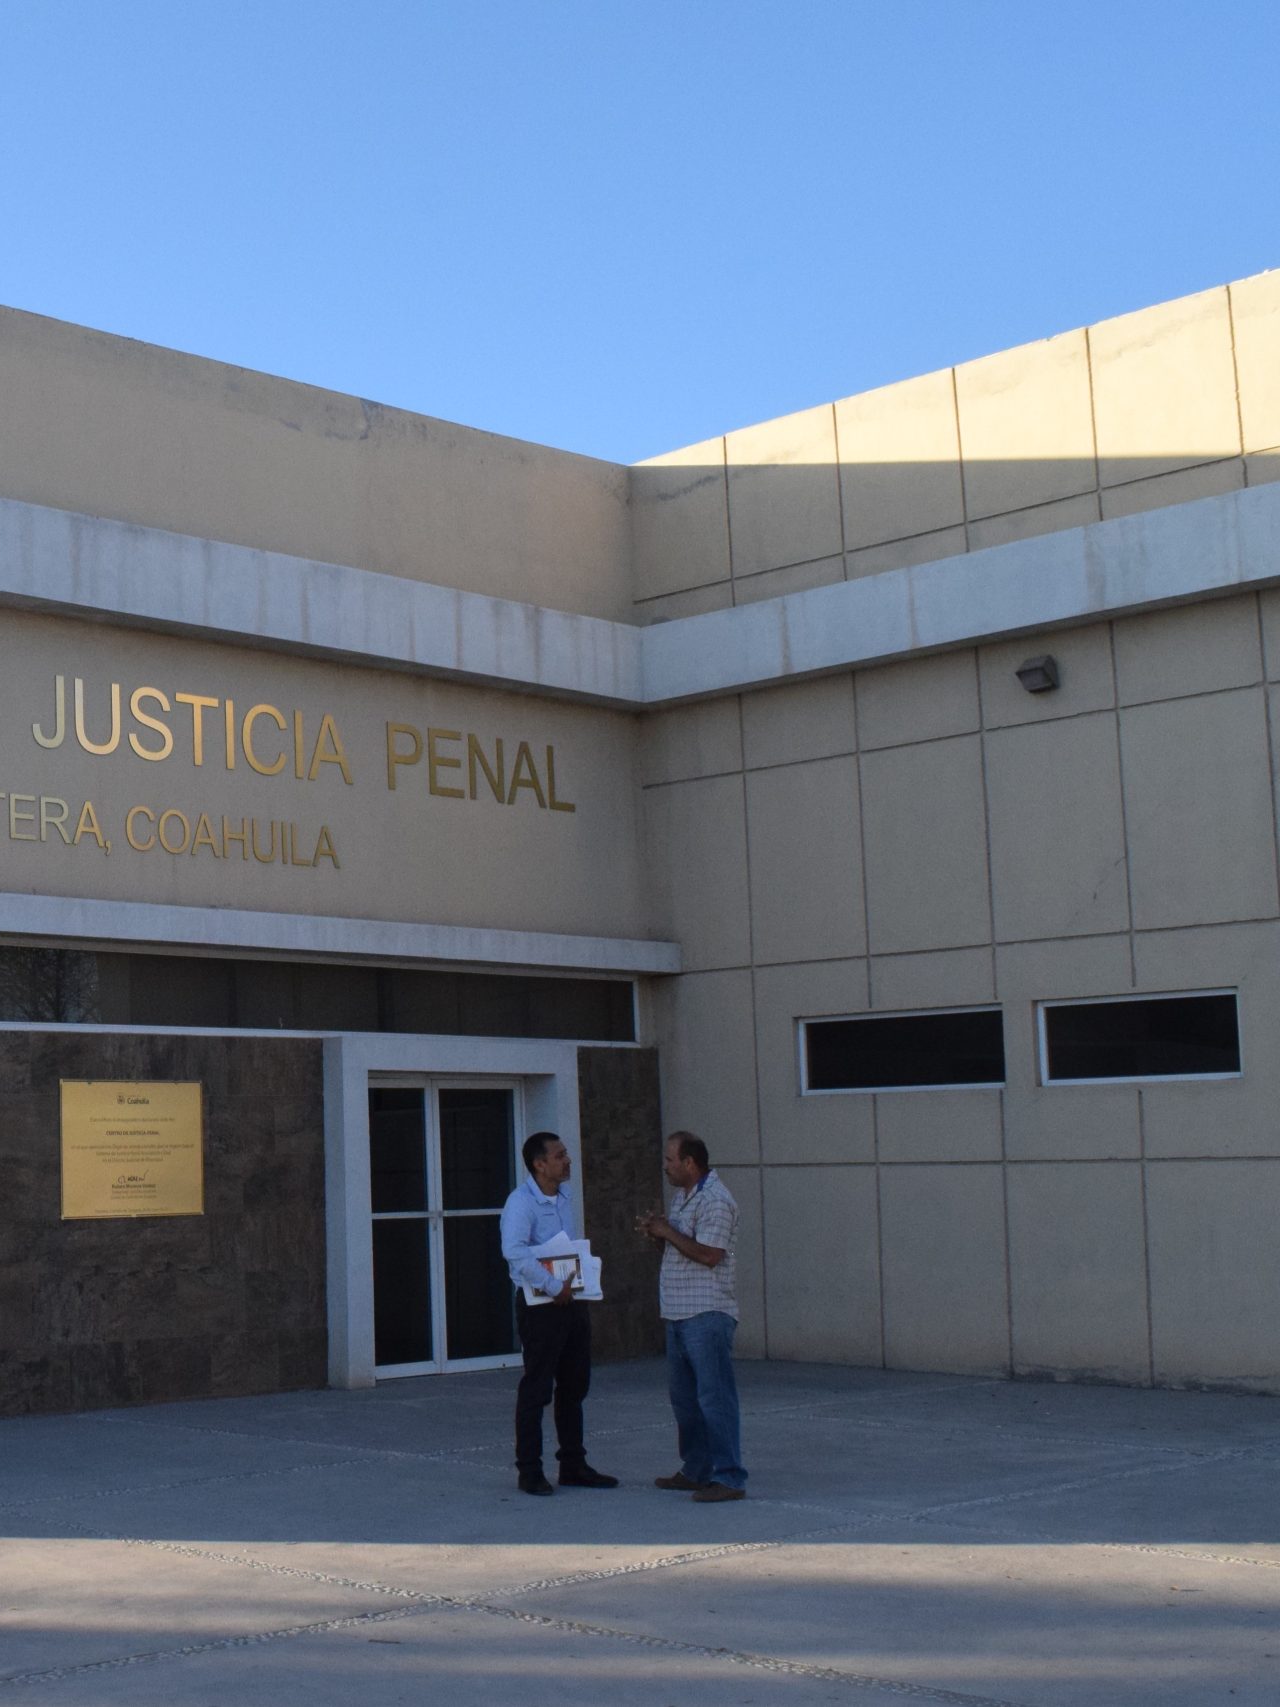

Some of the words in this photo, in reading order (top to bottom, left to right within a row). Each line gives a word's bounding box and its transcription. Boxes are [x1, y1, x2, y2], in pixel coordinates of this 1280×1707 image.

[32, 674, 354, 785] JUSTICIA
[387, 720, 576, 813] PENAL
[125, 805, 340, 869] COAHUILA
